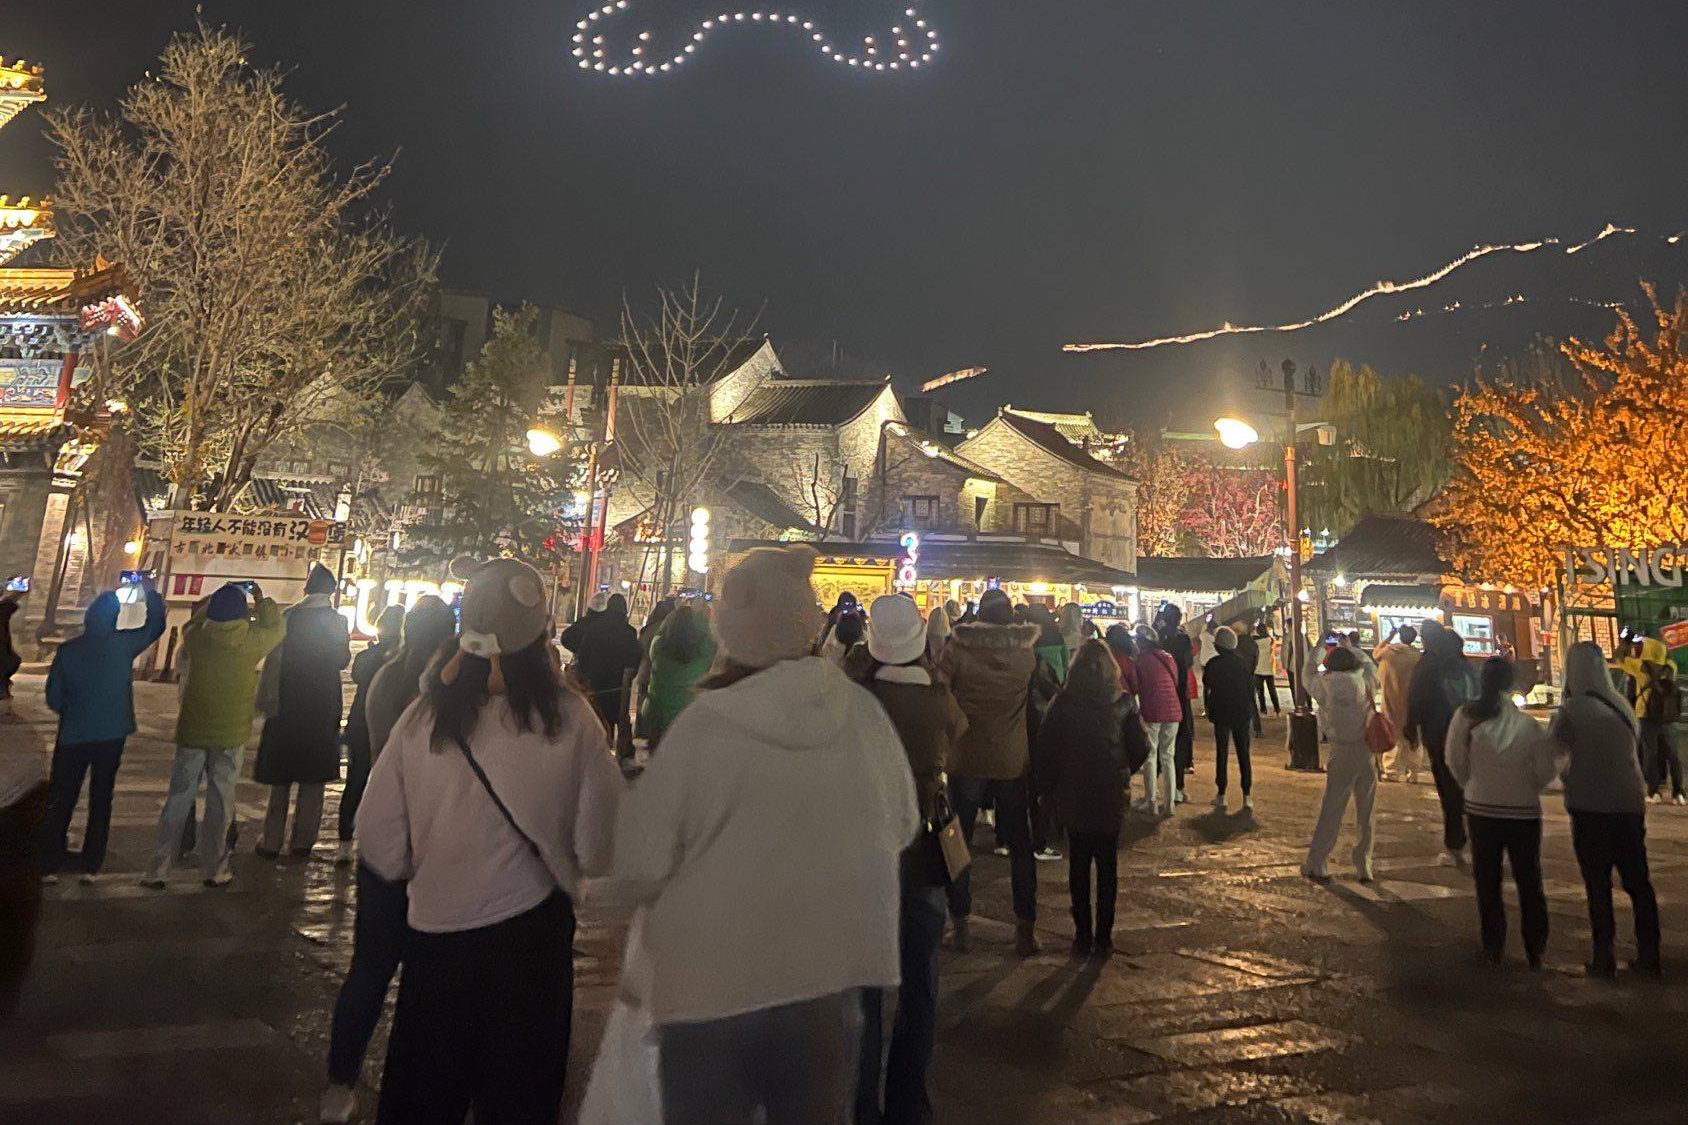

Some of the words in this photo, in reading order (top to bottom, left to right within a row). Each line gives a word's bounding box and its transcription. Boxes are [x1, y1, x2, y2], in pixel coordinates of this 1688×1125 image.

[181, 516, 347, 544] 年轻人不能没有汉堡
[1557, 547, 1688, 587] TSING
